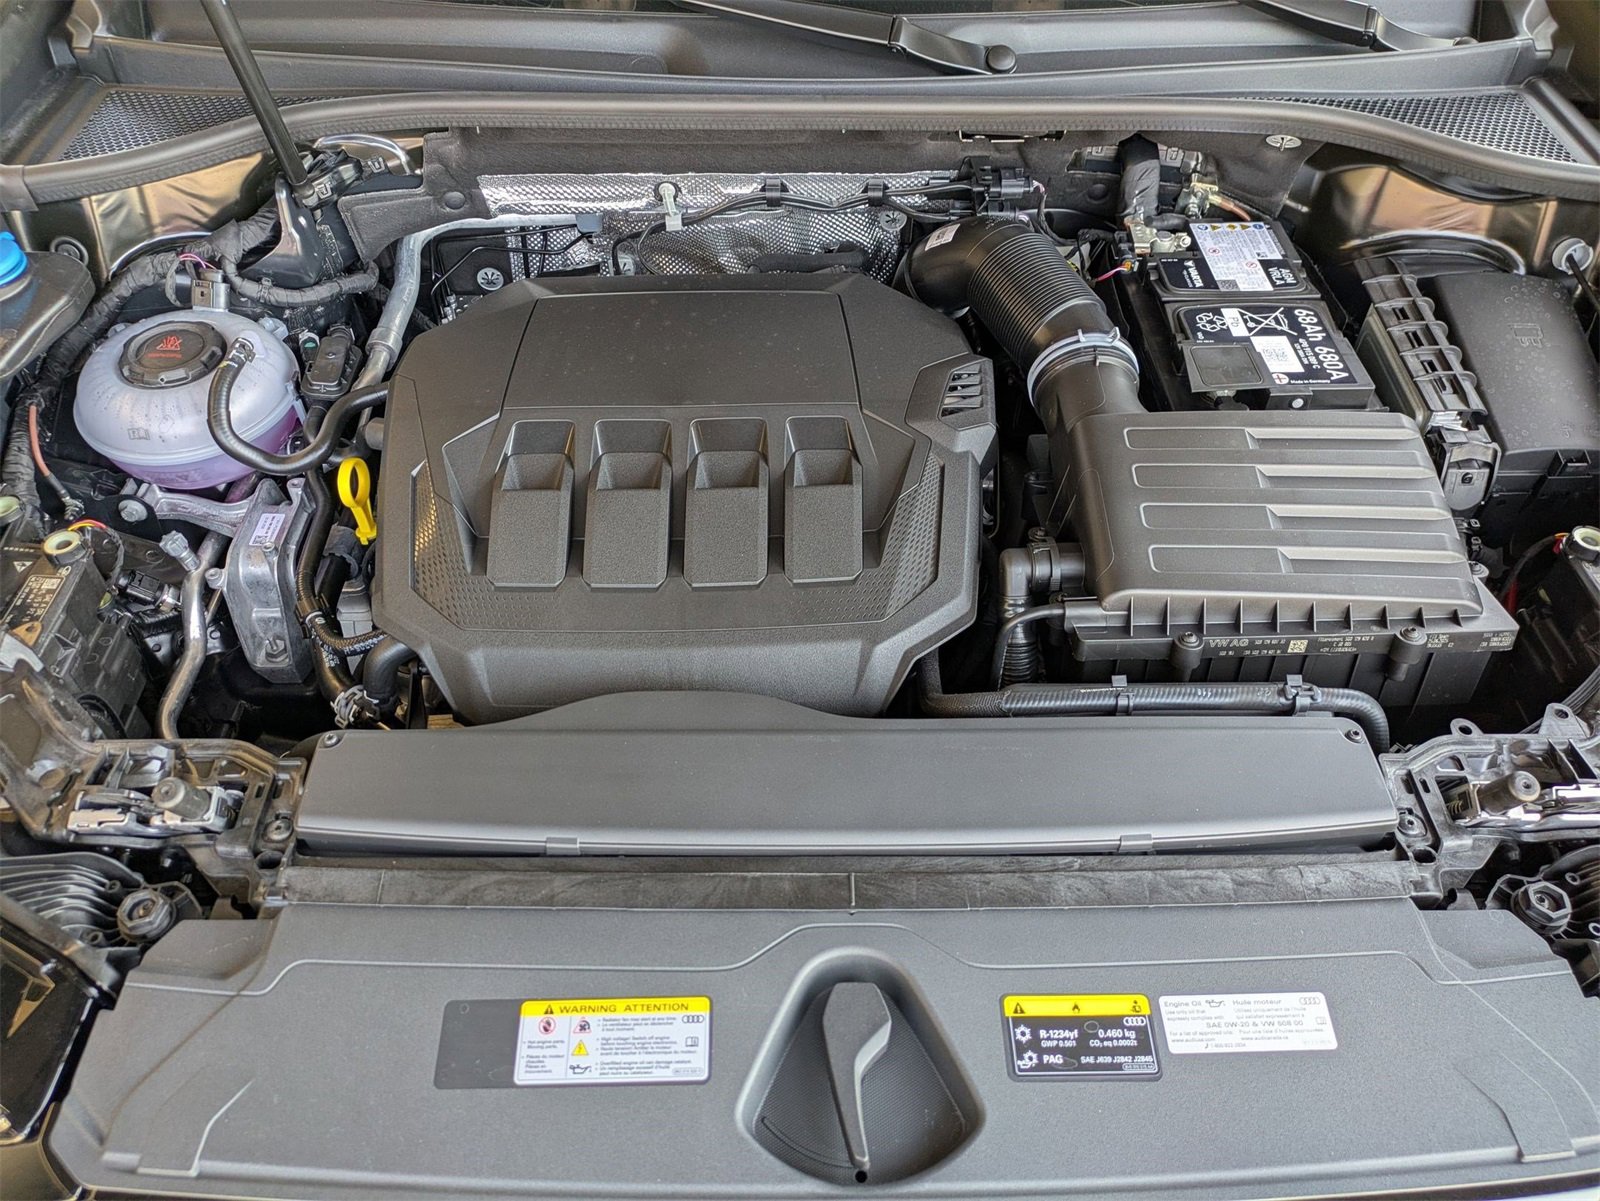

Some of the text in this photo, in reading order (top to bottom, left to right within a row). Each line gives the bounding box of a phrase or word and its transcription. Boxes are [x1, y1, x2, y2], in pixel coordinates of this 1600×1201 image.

[1189, 266, 1204, 288] VARTA
[1267, 267, 1286, 286] VRLA
[1279, 268, 1297, 284] AGM
[1228, 316, 1240, 329] Pb
[1294, 308, 1326, 342] 68Ah
[1314, 345, 1349, 381] 680A
[1209, 639, 1230, 648] VW
[1229, 638, 1250, 647] AG
[559, 1002, 689, 1014] WARNING ATTENTION
[1163, 1000, 1190, 1009] Engine
[1253, 998, 1282, 1006] moteur
[1039, 1029, 1136, 1039] R-1234yf 0.460 kg
[1043, 1054, 1064, 1064] PAG
[1080, 1055, 1095, 1064] SAE
[1096, 1055, 1113, 1064] J639
[1113, 1055, 1133, 1063] J2842
